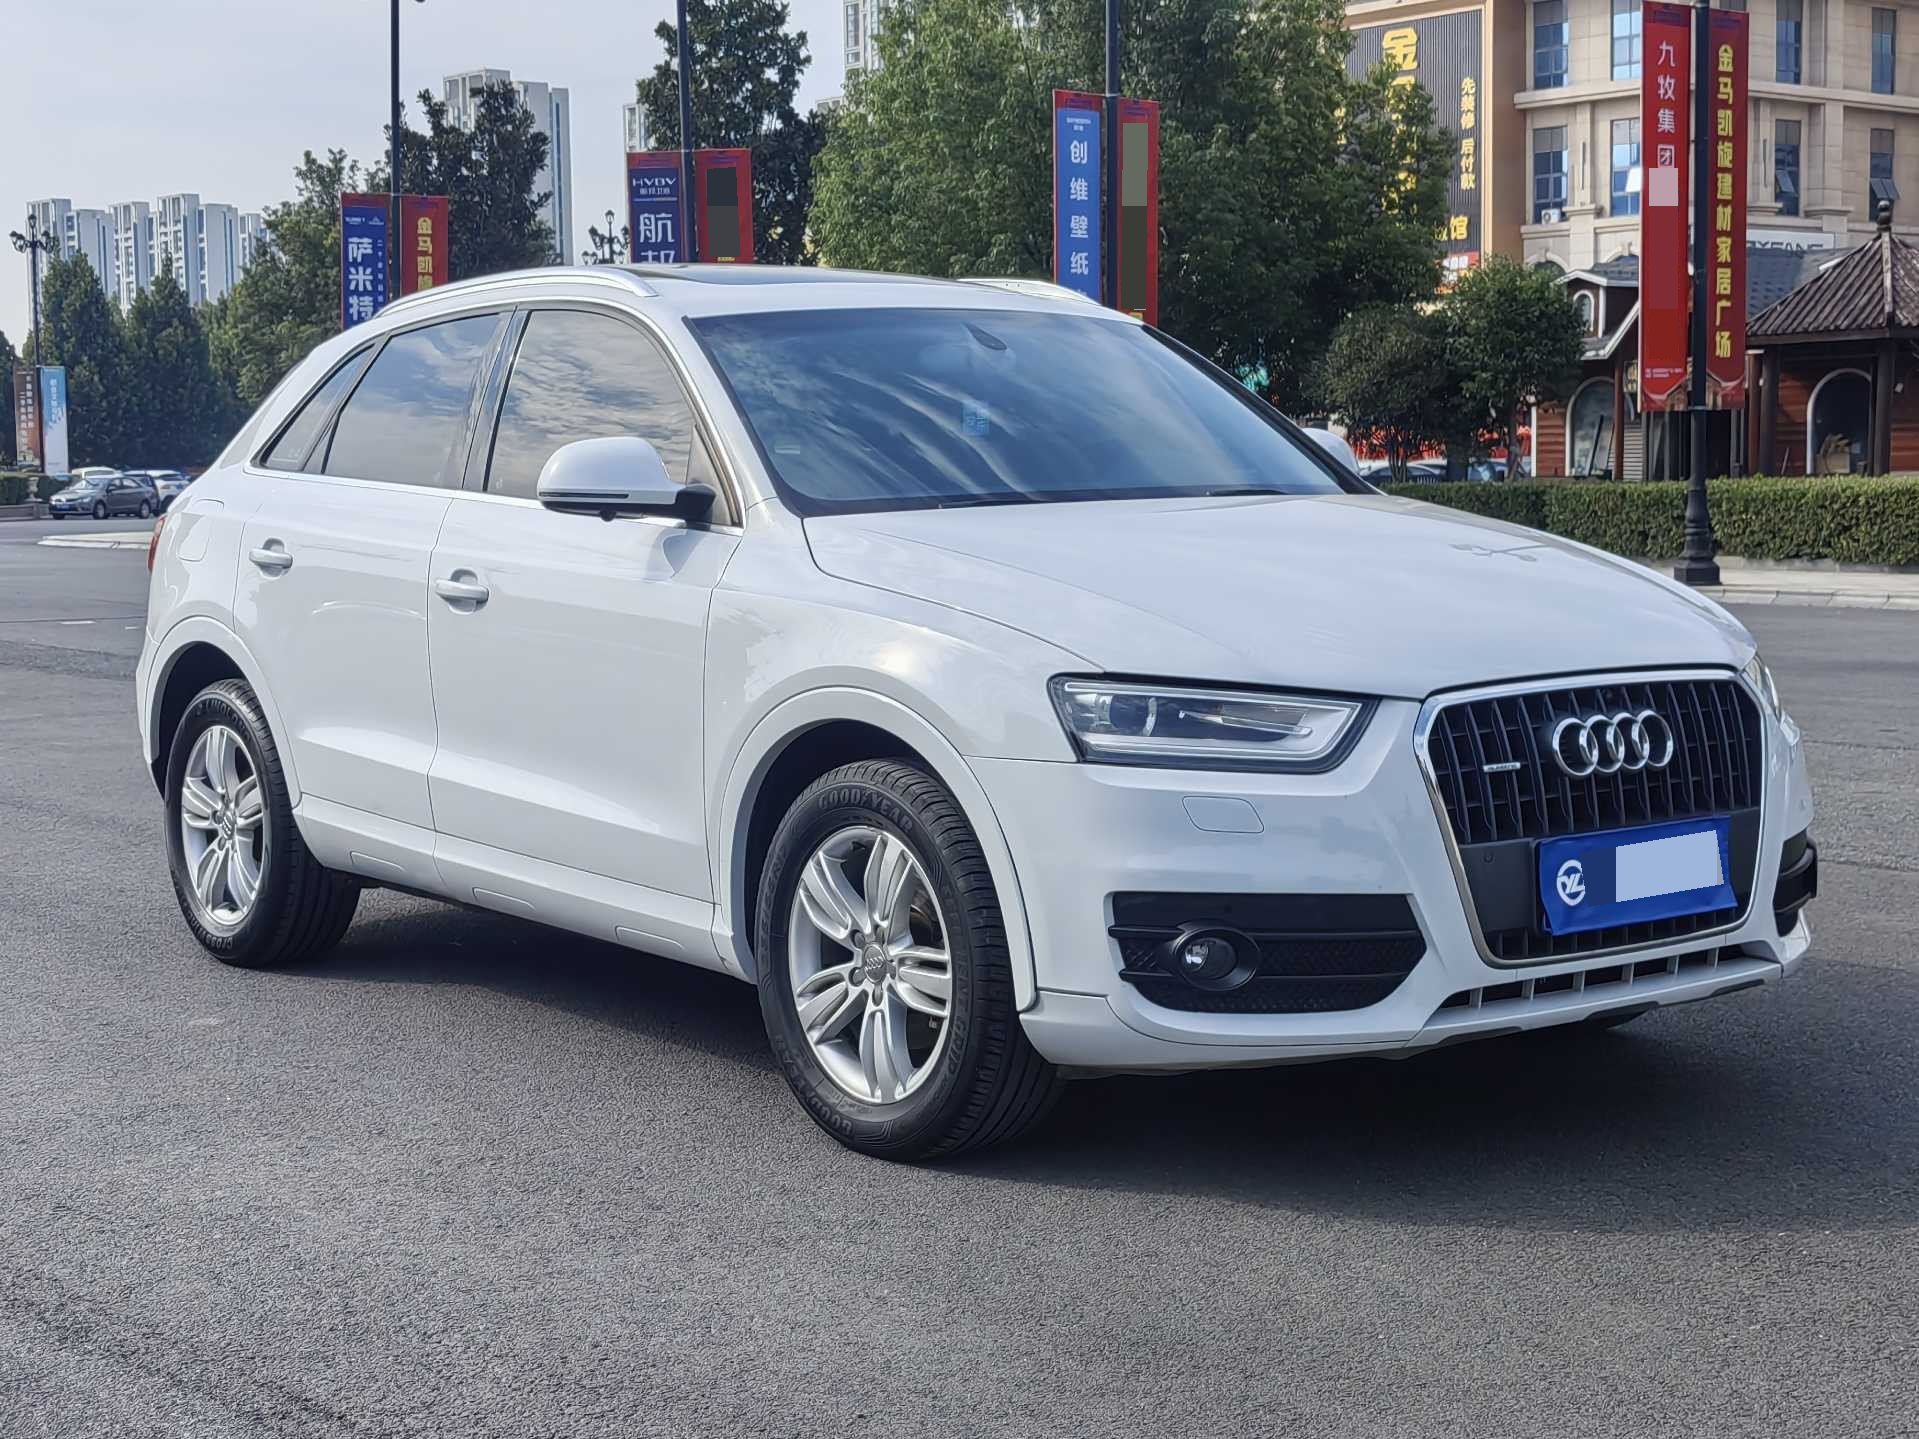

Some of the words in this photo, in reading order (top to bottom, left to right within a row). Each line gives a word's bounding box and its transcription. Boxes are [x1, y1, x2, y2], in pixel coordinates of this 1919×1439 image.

[1657, 40, 1676, 169] 九牧集团
[1069, 140, 1088, 297] 创维壁纸
[1715, 43, 1734, 358] 金马凯旋建材家居广场
[347, 236, 374, 321] 萨米特
